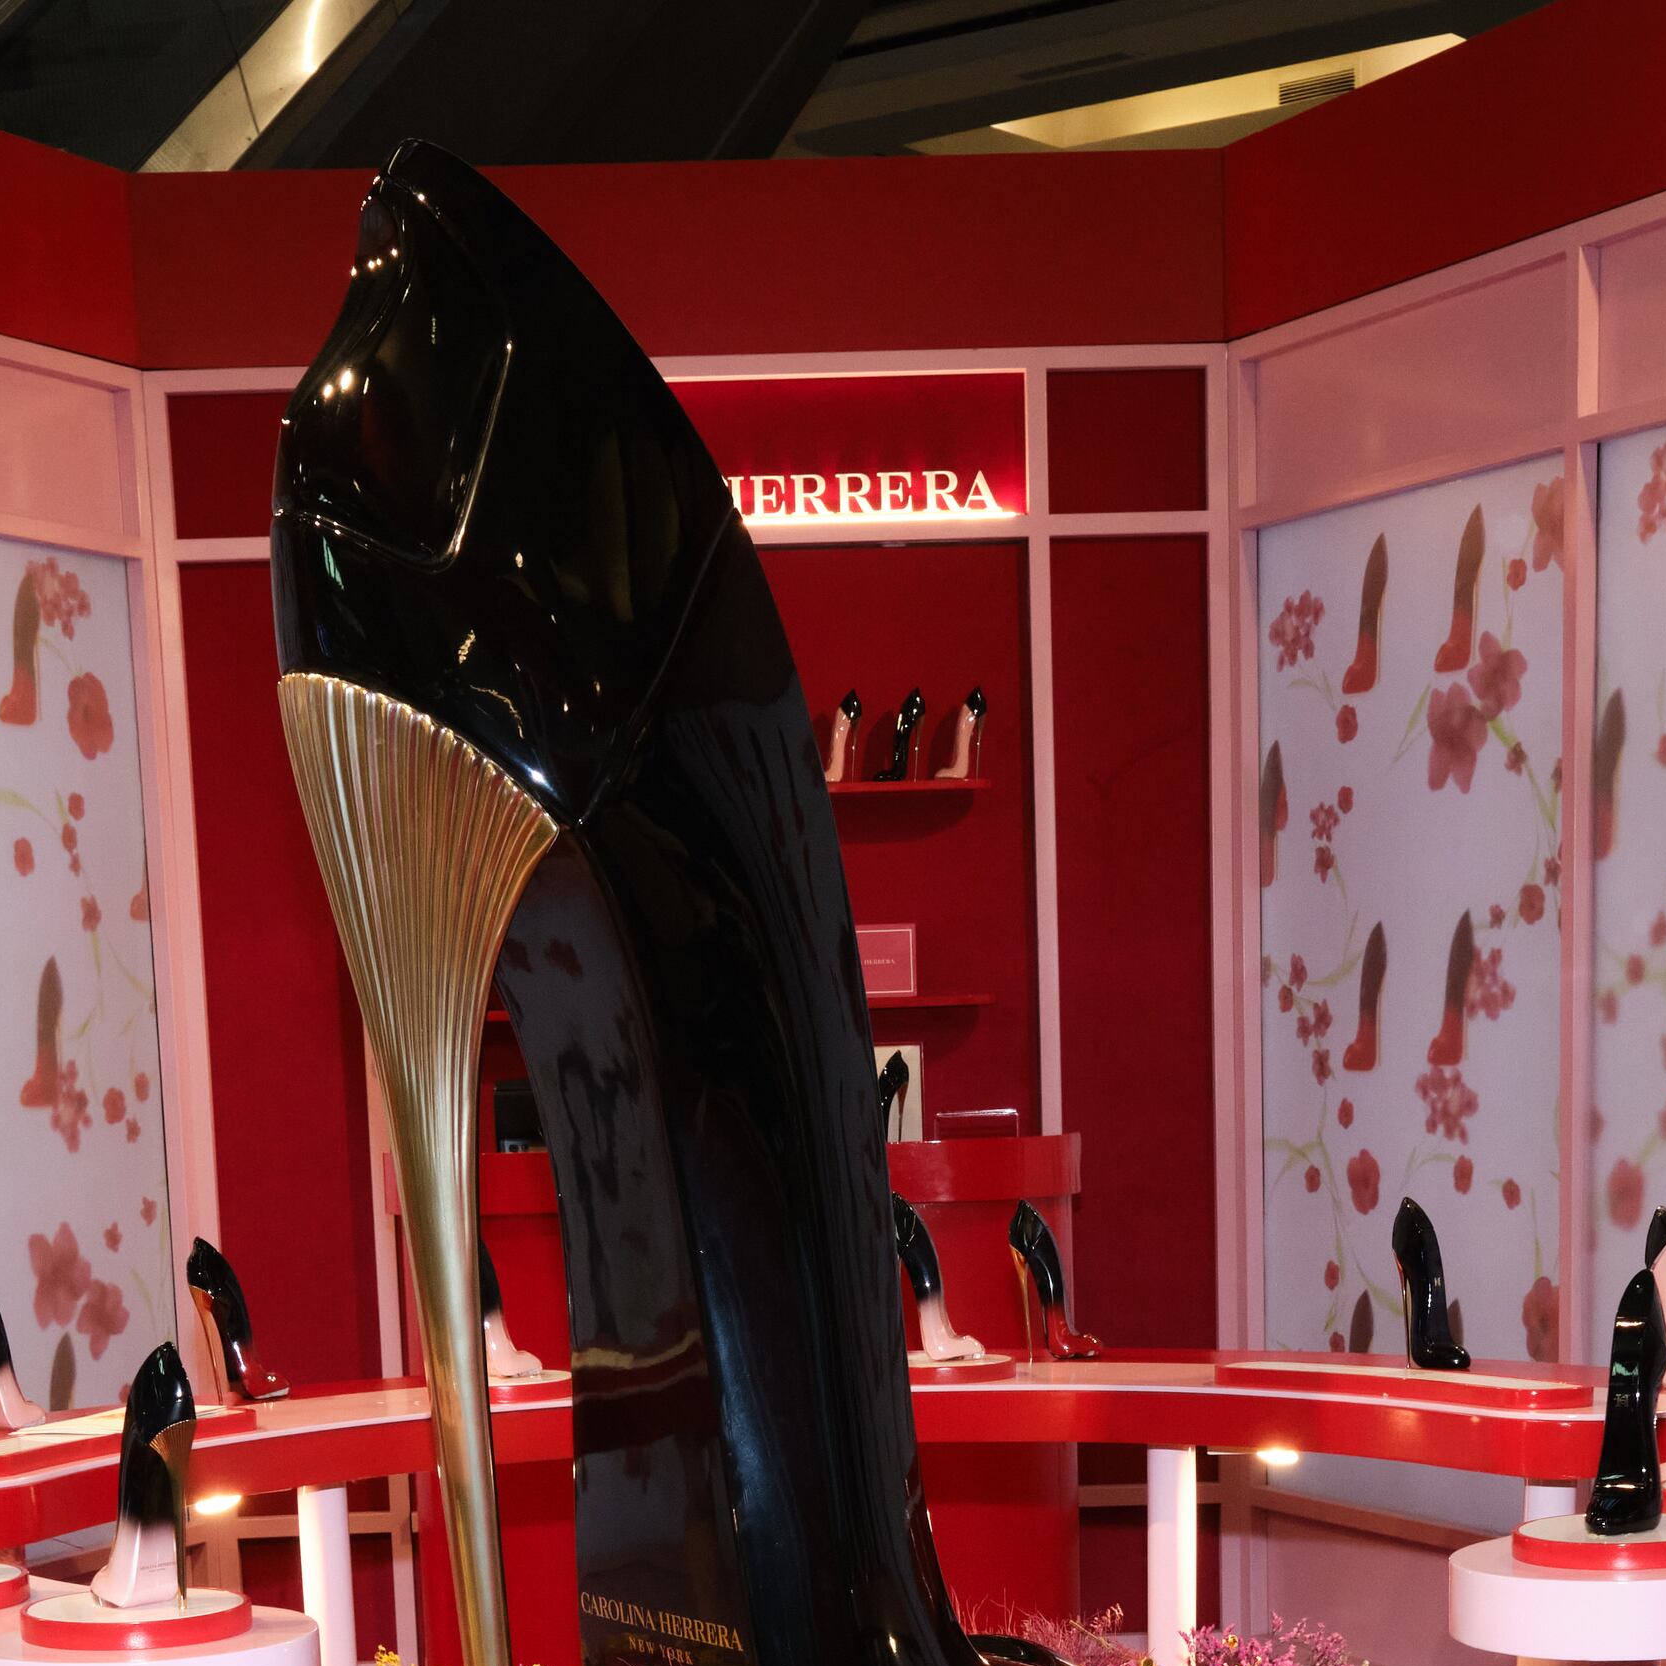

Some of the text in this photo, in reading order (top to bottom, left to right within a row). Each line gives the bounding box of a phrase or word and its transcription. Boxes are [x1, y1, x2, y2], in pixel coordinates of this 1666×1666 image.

[581, 1591, 744, 1652] CAROLINA HERRERA
[629, 1635, 694, 1666] NEW YORK
